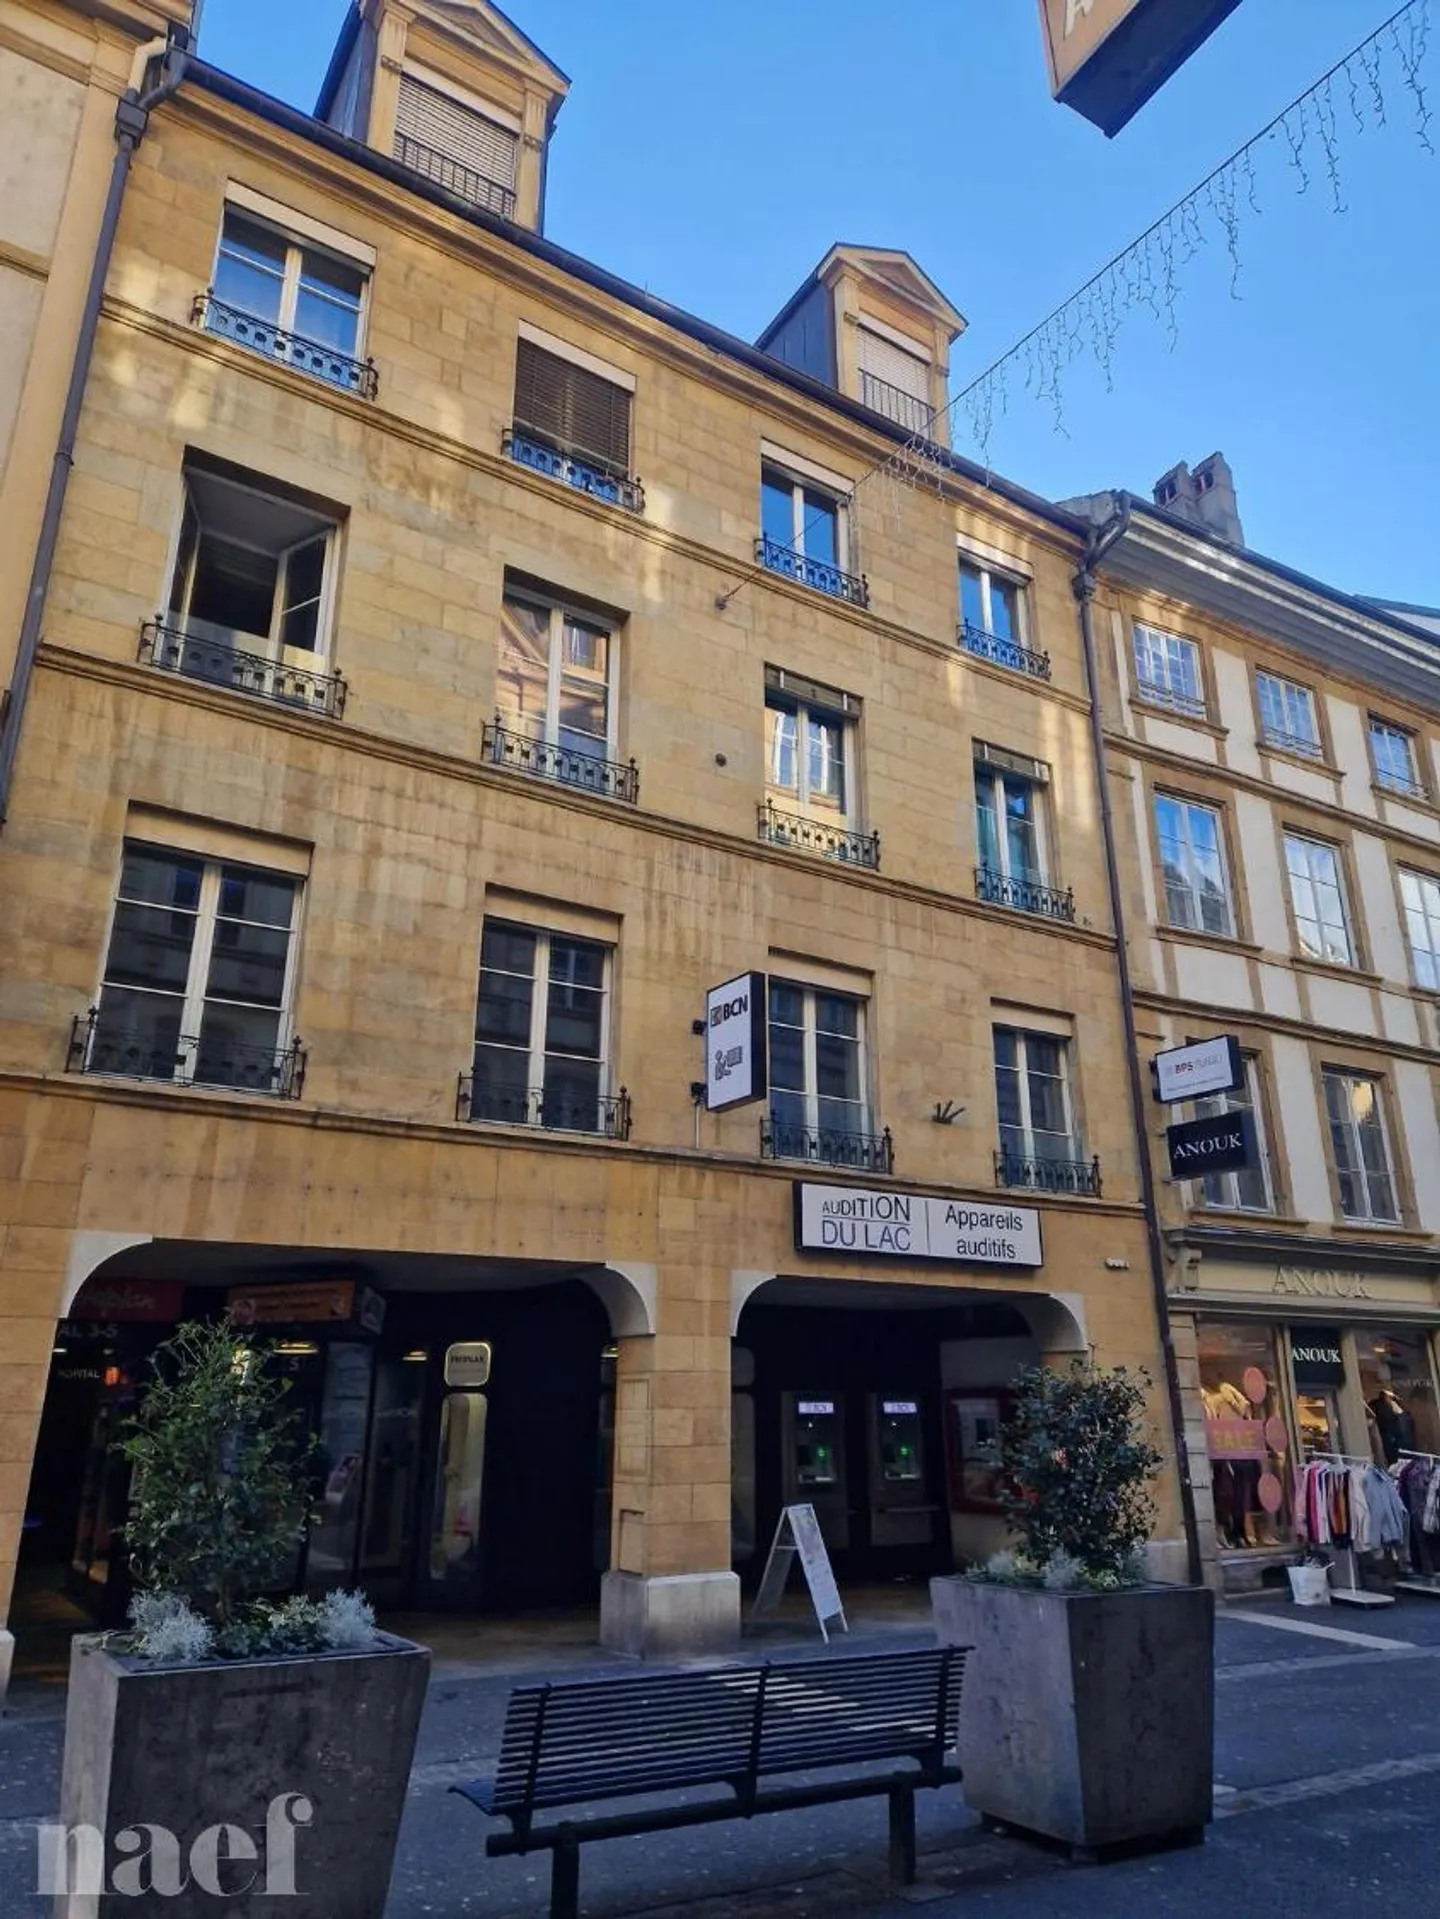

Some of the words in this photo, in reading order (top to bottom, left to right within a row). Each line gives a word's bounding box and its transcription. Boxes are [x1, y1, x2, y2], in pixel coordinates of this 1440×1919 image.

[723, 994, 748, 1021] BCN
[1175, 1061, 1194, 1074] BPS
[1173, 1132, 1243, 1159] ANOUK
[822, 1195, 911, 1222] AUDITION
[945, 1204, 1024, 1231] Appareils
[822, 1220, 856, 1247] DU
[865, 1226, 912, 1252] LAC
[957, 1237, 1016, 1259] auditifs
[1272, 1264, 1374, 1300] ANOUK
[1291, 1347, 1342, 1363] ANOUK
[1212, 1429, 1257, 1450] SALE
